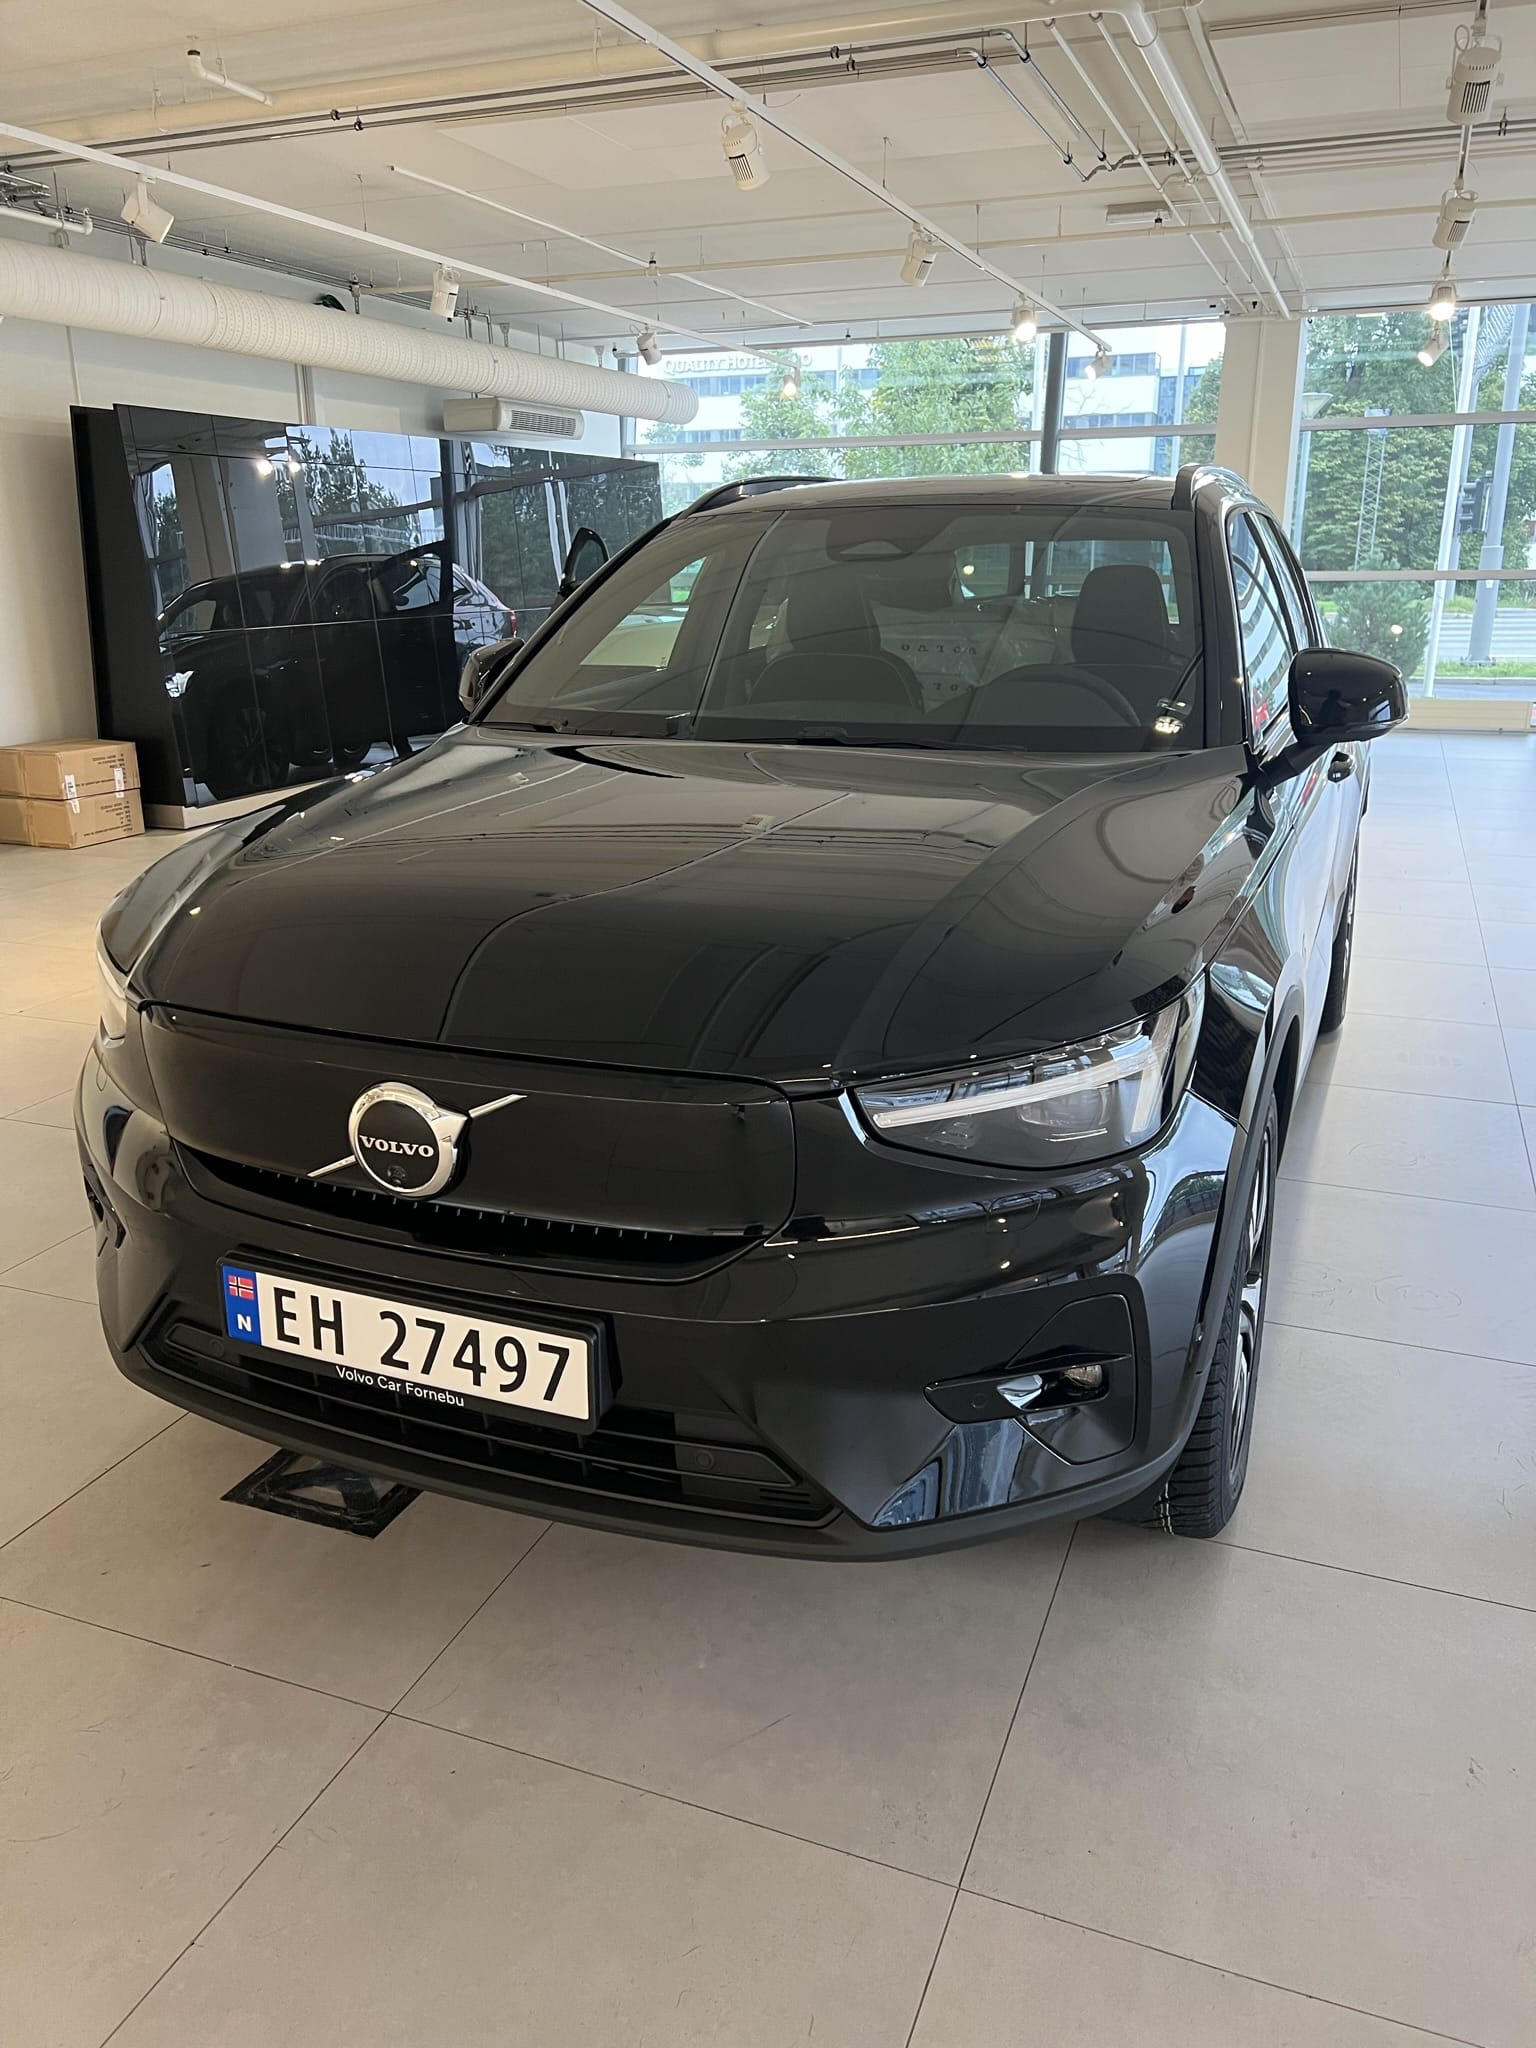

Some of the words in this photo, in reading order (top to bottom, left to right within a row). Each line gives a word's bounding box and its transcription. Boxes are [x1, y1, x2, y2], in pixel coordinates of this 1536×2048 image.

[664, 358, 721, 375] QUALITY
[359, 1135, 434, 1157] VOLVO
[237, 1313, 252, 1332] N
[273, 1286, 345, 1356] EH
[379, 1310, 570, 1402] 27497
[335, 1365, 374, 1386] Volvo
[377, 1376, 401, 1392] Car
[405, 1382, 465, 1407] Fornebu
